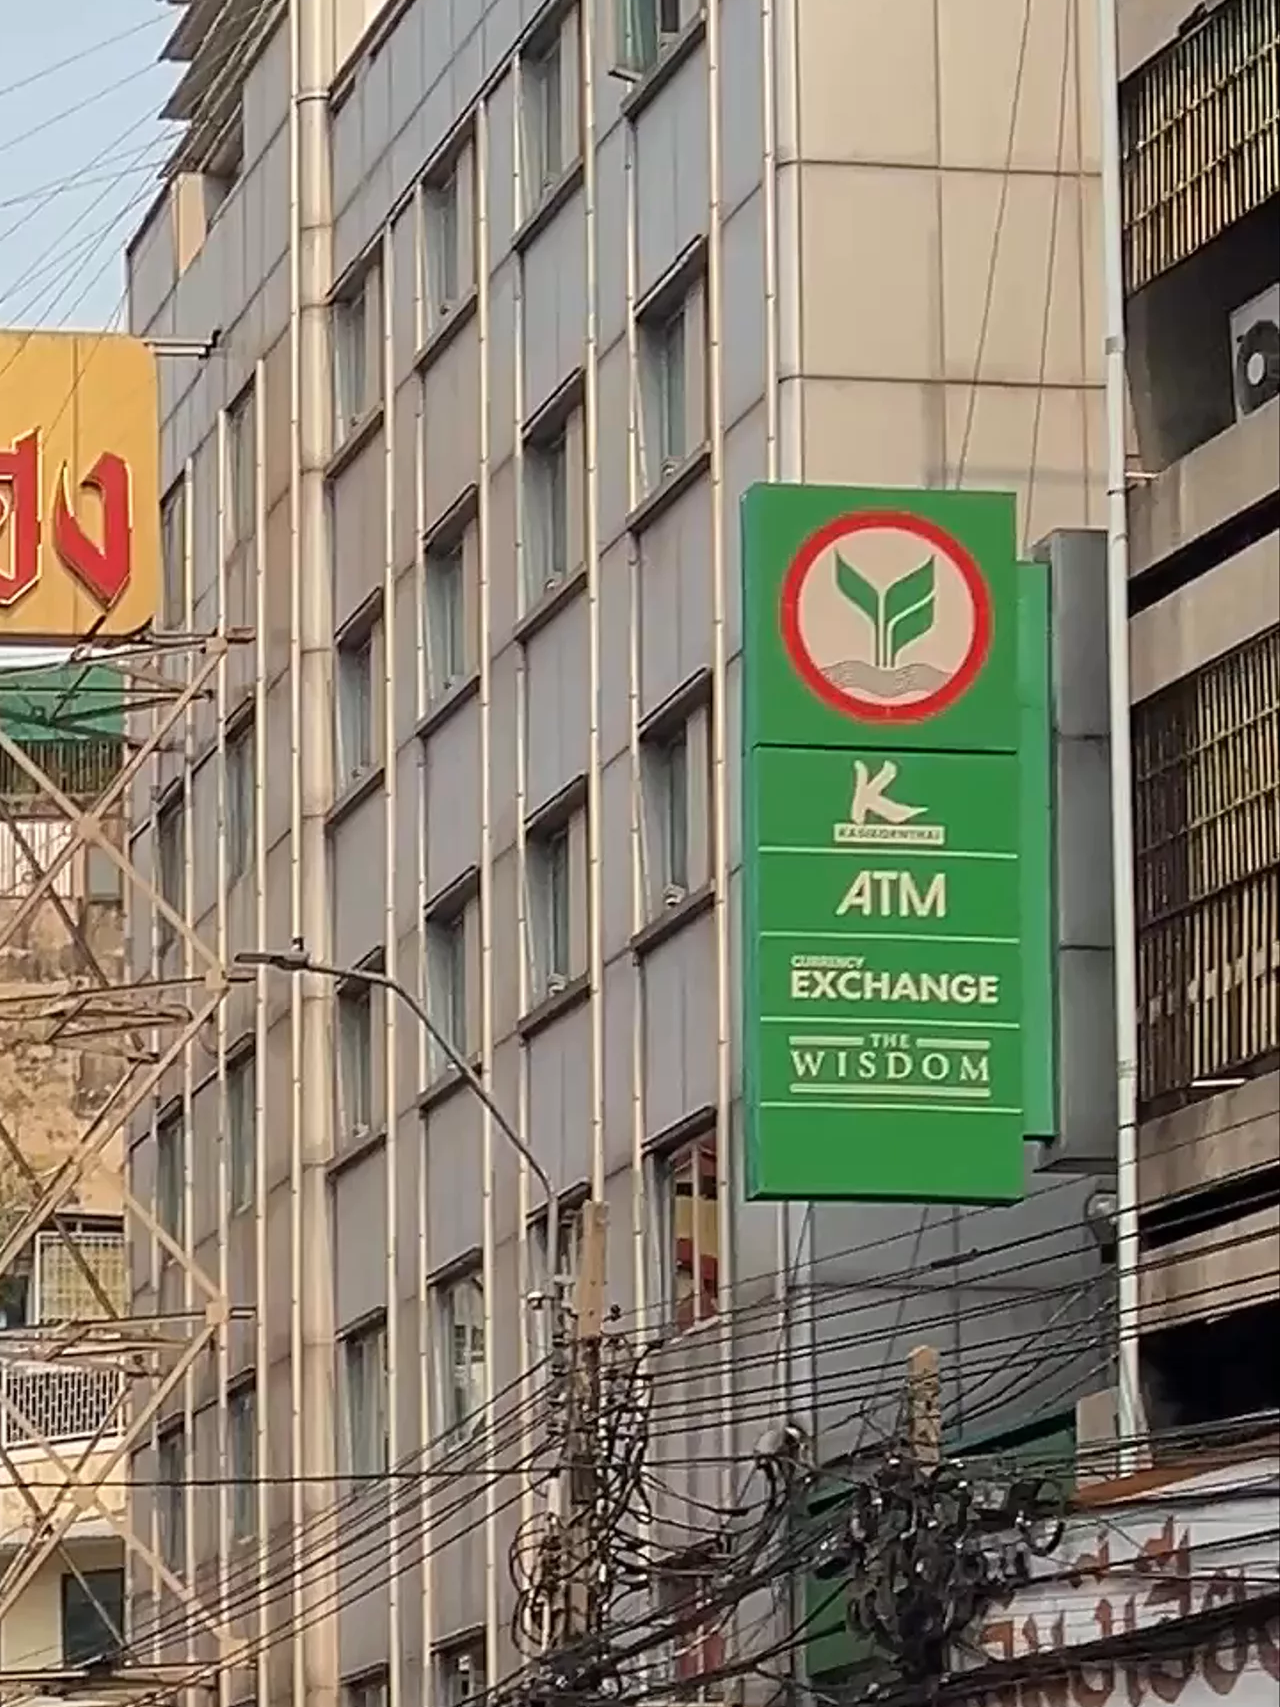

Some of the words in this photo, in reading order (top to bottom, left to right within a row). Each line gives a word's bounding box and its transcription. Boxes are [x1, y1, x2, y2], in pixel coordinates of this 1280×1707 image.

[836, 870, 947, 918] ATM
[790, 956, 864, 969] CURRENCY
[790, 970, 1000, 1005] EXCHANGE
[870, 1034, 911, 1050] THE
[790, 1050, 991, 1082] WISDOM
